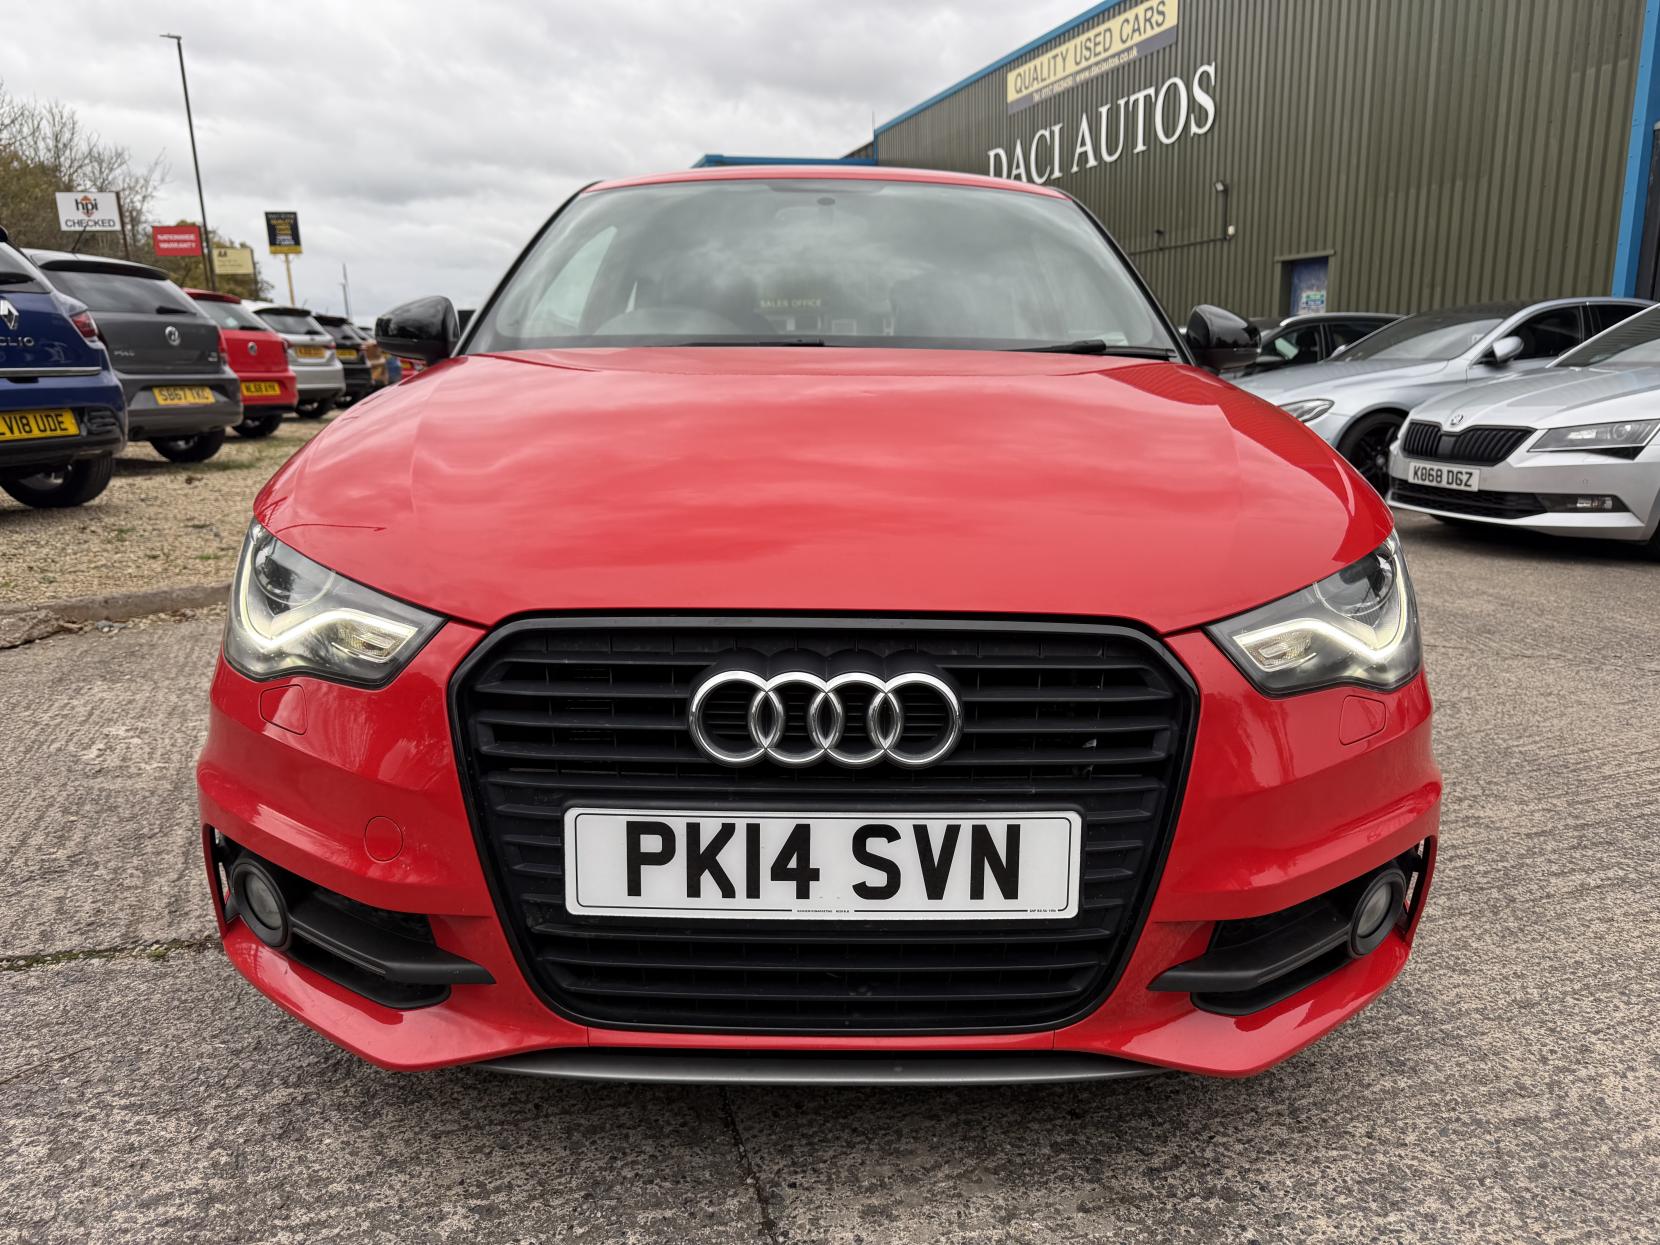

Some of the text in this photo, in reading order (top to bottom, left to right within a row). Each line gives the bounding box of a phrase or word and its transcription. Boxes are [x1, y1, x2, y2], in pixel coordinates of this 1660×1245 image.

[1013, 47, 1070, 95] QUALITY
[1074, 28, 1113, 66] USED
[1119, 0, 1167, 44] CARS
[987, 61, 1216, 185] DACI AUTOS
[74, 198, 98, 215] hpi
[64, 219, 116, 228] CHECKED
[760, 299, 788, 308] SALES
[0, 336, 35, 347] CLIO
[33, 413, 69, 433] UDE
[1446, 469, 1473, 488] DGZ
[626, 820, 1021, 901] PK14 SVN
